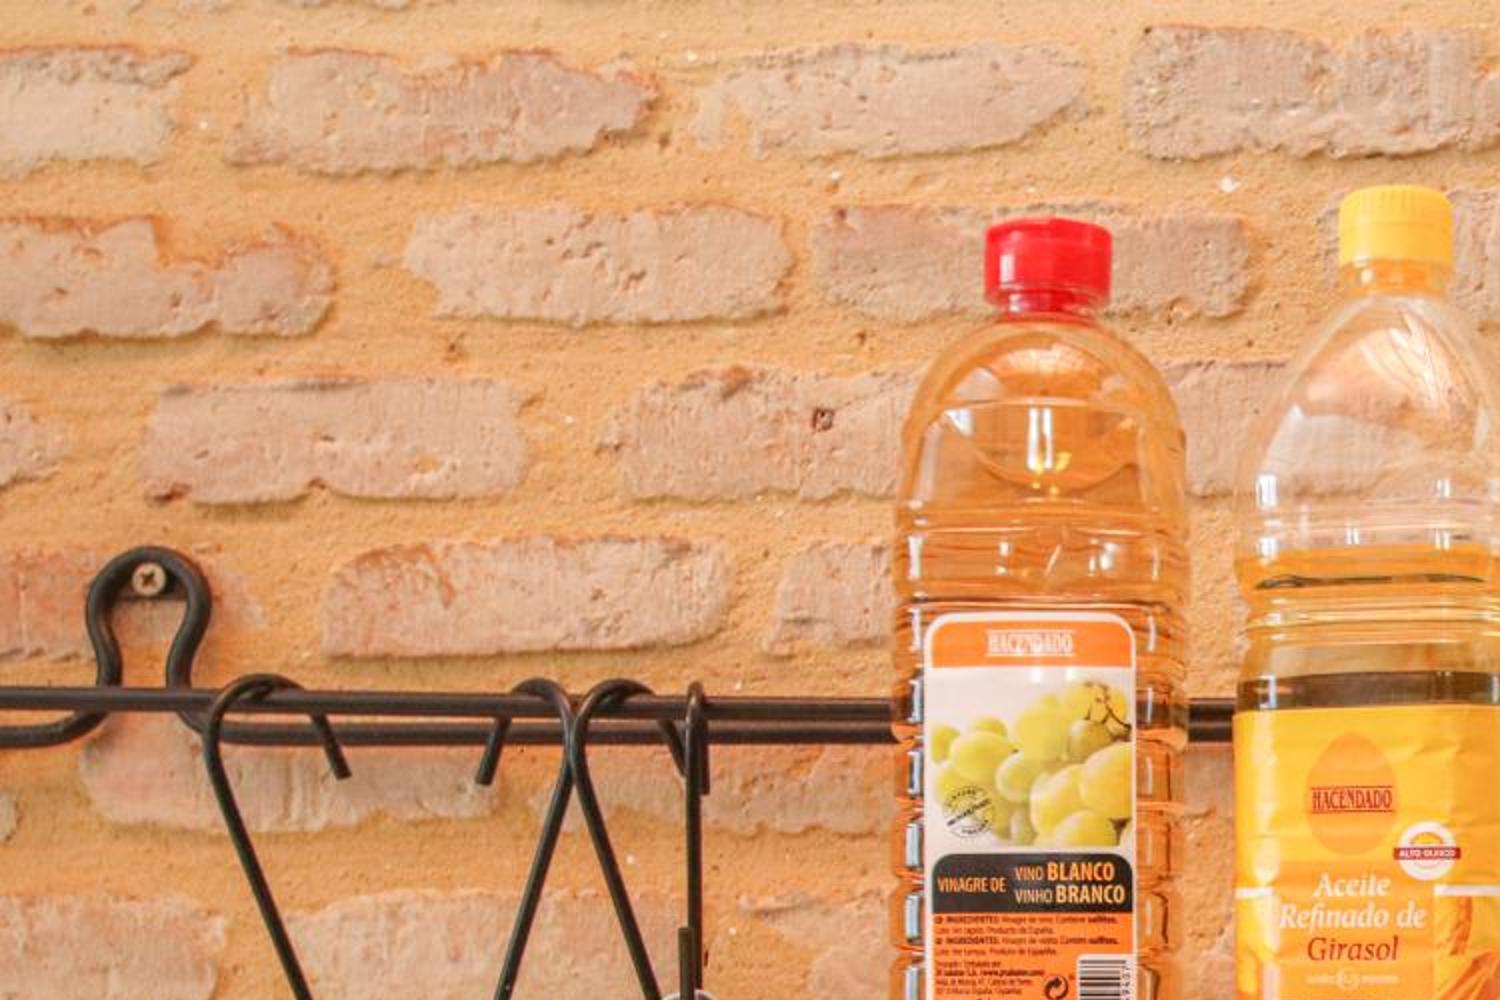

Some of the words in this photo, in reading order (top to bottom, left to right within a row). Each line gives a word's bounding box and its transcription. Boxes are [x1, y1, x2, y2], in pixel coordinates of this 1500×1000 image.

[988, 633, 1072, 653] HACENDADO
[1313, 787, 1392, 810] HACENDADO
[1015, 866, 1043, 880] VINO
[1047, 863, 1114, 881] BLANCO
[937, 877, 987, 892] VINAGRE
[990, 877, 1006, 892] DE
[1015, 888, 1052, 902] VINHO
[1055, 885, 1125, 903] BRANCO
[1313, 874, 1391, 897] Aceite
[1280, 903, 1389, 931] Refinado
[1396, 902, 1426, 927] de
[1307, 936, 1398, 961] Girasol
